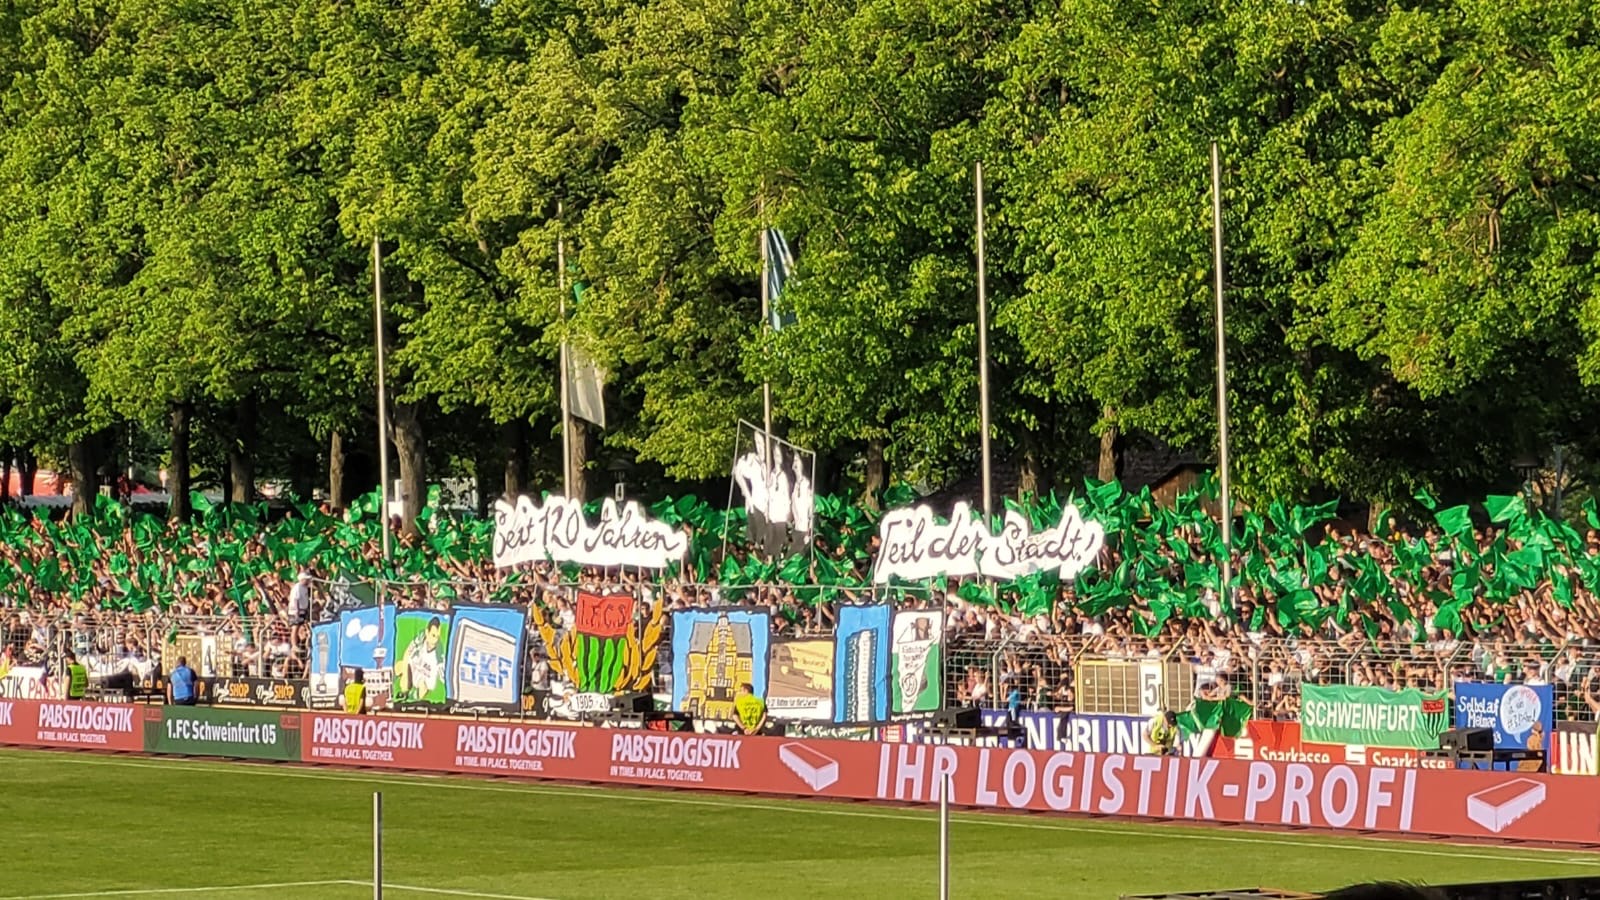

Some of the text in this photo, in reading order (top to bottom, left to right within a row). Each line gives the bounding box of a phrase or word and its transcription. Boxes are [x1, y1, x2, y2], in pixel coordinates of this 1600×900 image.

[495, 505, 680, 557] Seit 120 Jahren
[876, 512, 1095, 573] Teil der Stadt!
[461, 646, 512, 689] SKF
[229, 682, 250, 698] SHOP
[273, 684, 294, 699] SHOP
[1144, 674, 1157, 706] 5
[39, 703, 134, 732] PABSTLOGISTIK
[166, 718, 190, 739] 1.FC
[192, 720, 261, 744] Schweinfurt
[262, 723, 277, 745] 05
[1305, 700, 1419, 732] SCHWEINFURT
[63, 732, 79, 742] PLACE.
[313, 717, 424, 749] PABSTLOGISTIK
[457, 725, 577, 759] PABSTLOGISTIK
[312, 747, 319, 756] IN
[342, 748, 361, 759] PLACE.
[362, 749, 394, 761] TOGETHER.
[455, 756, 463, 766] IN
[480, 757, 487, 767] IN
[488, 757, 508, 769] PLACE.
[509, 759, 544, 771] TOGETHER.
[611, 733, 741, 769] PABSTLOGISTIK
[610, 765, 704, 782] IN TIME. IN PLACE. TOGETHER.
[877, 744, 1418, 832] IHR LOGISTIK-PROFI
